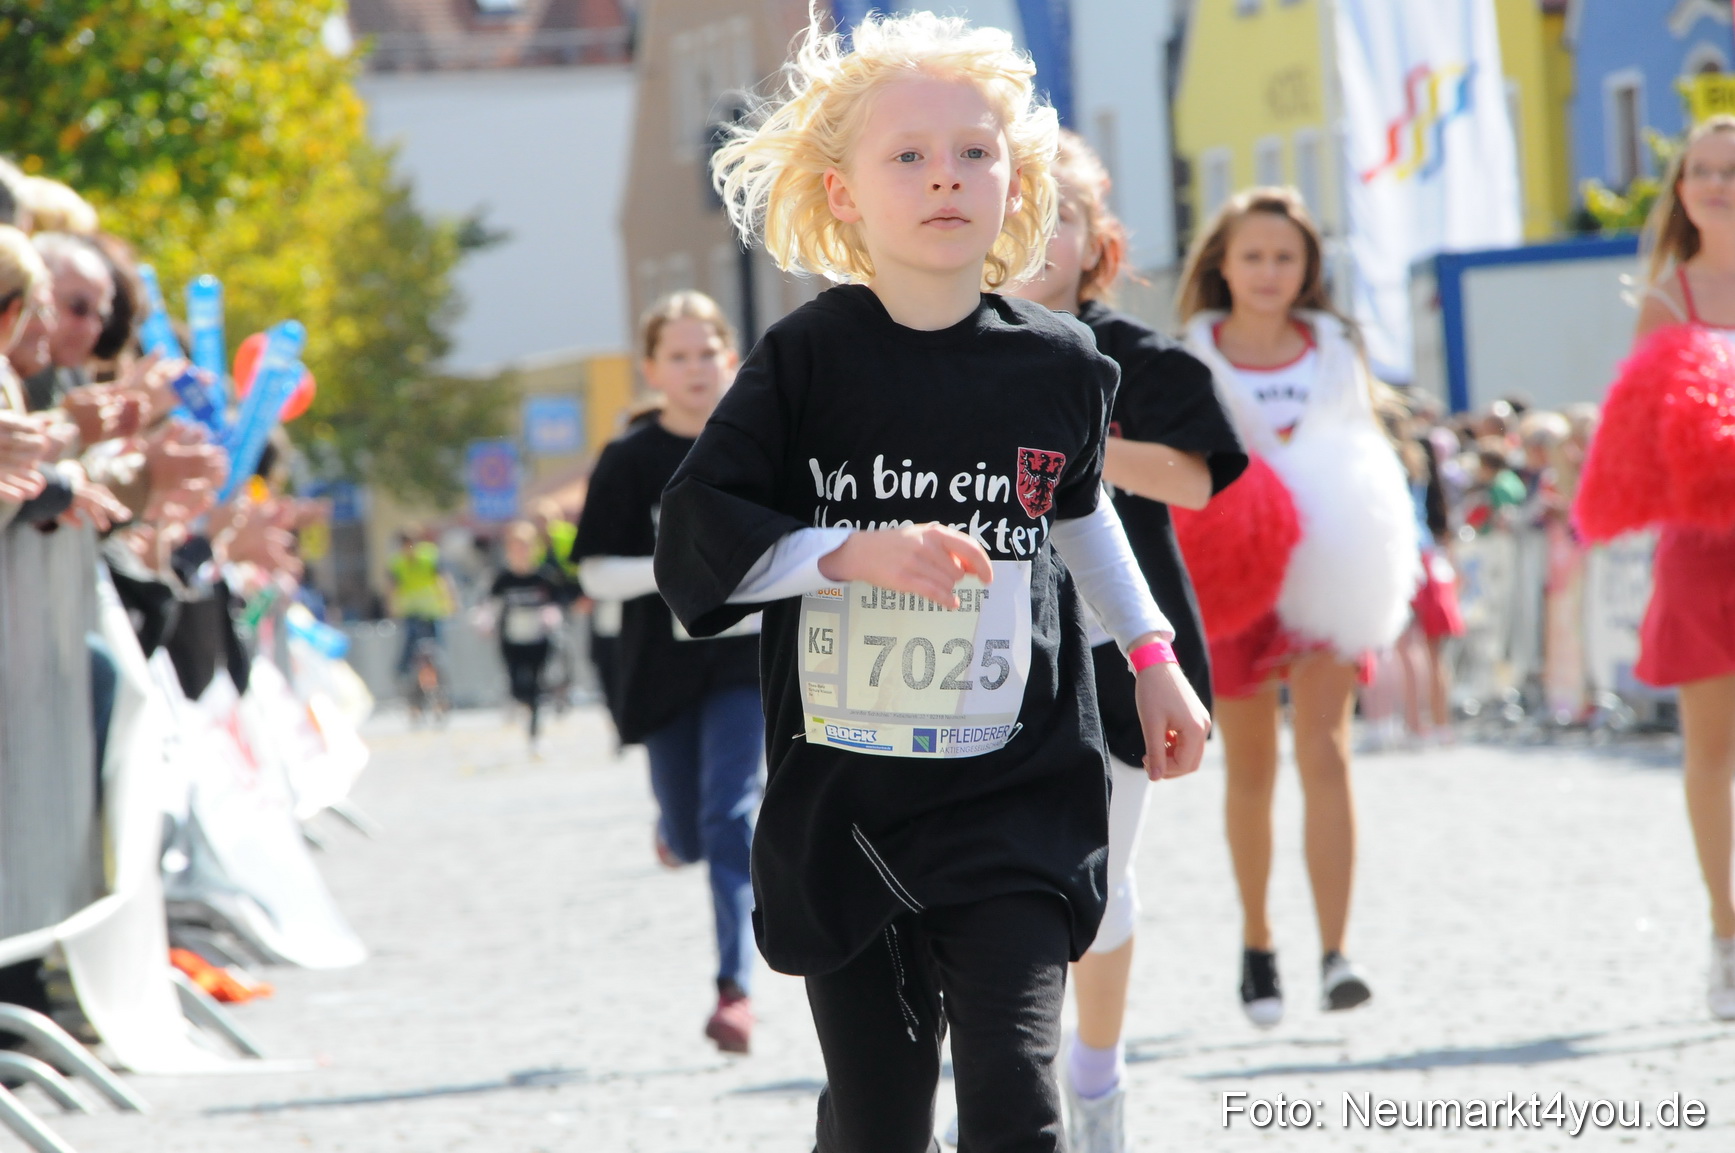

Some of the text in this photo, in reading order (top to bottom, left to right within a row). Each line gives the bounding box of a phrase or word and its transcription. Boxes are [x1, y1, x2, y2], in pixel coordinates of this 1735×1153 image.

[808, 453, 1010, 503] Ich bin ein
[808, 627, 834, 655] K5
[863, 635, 1010, 691] 7025
[825, 725, 877, 743] BOCK
[940, 725, 1010, 744] PFLEIDERER
